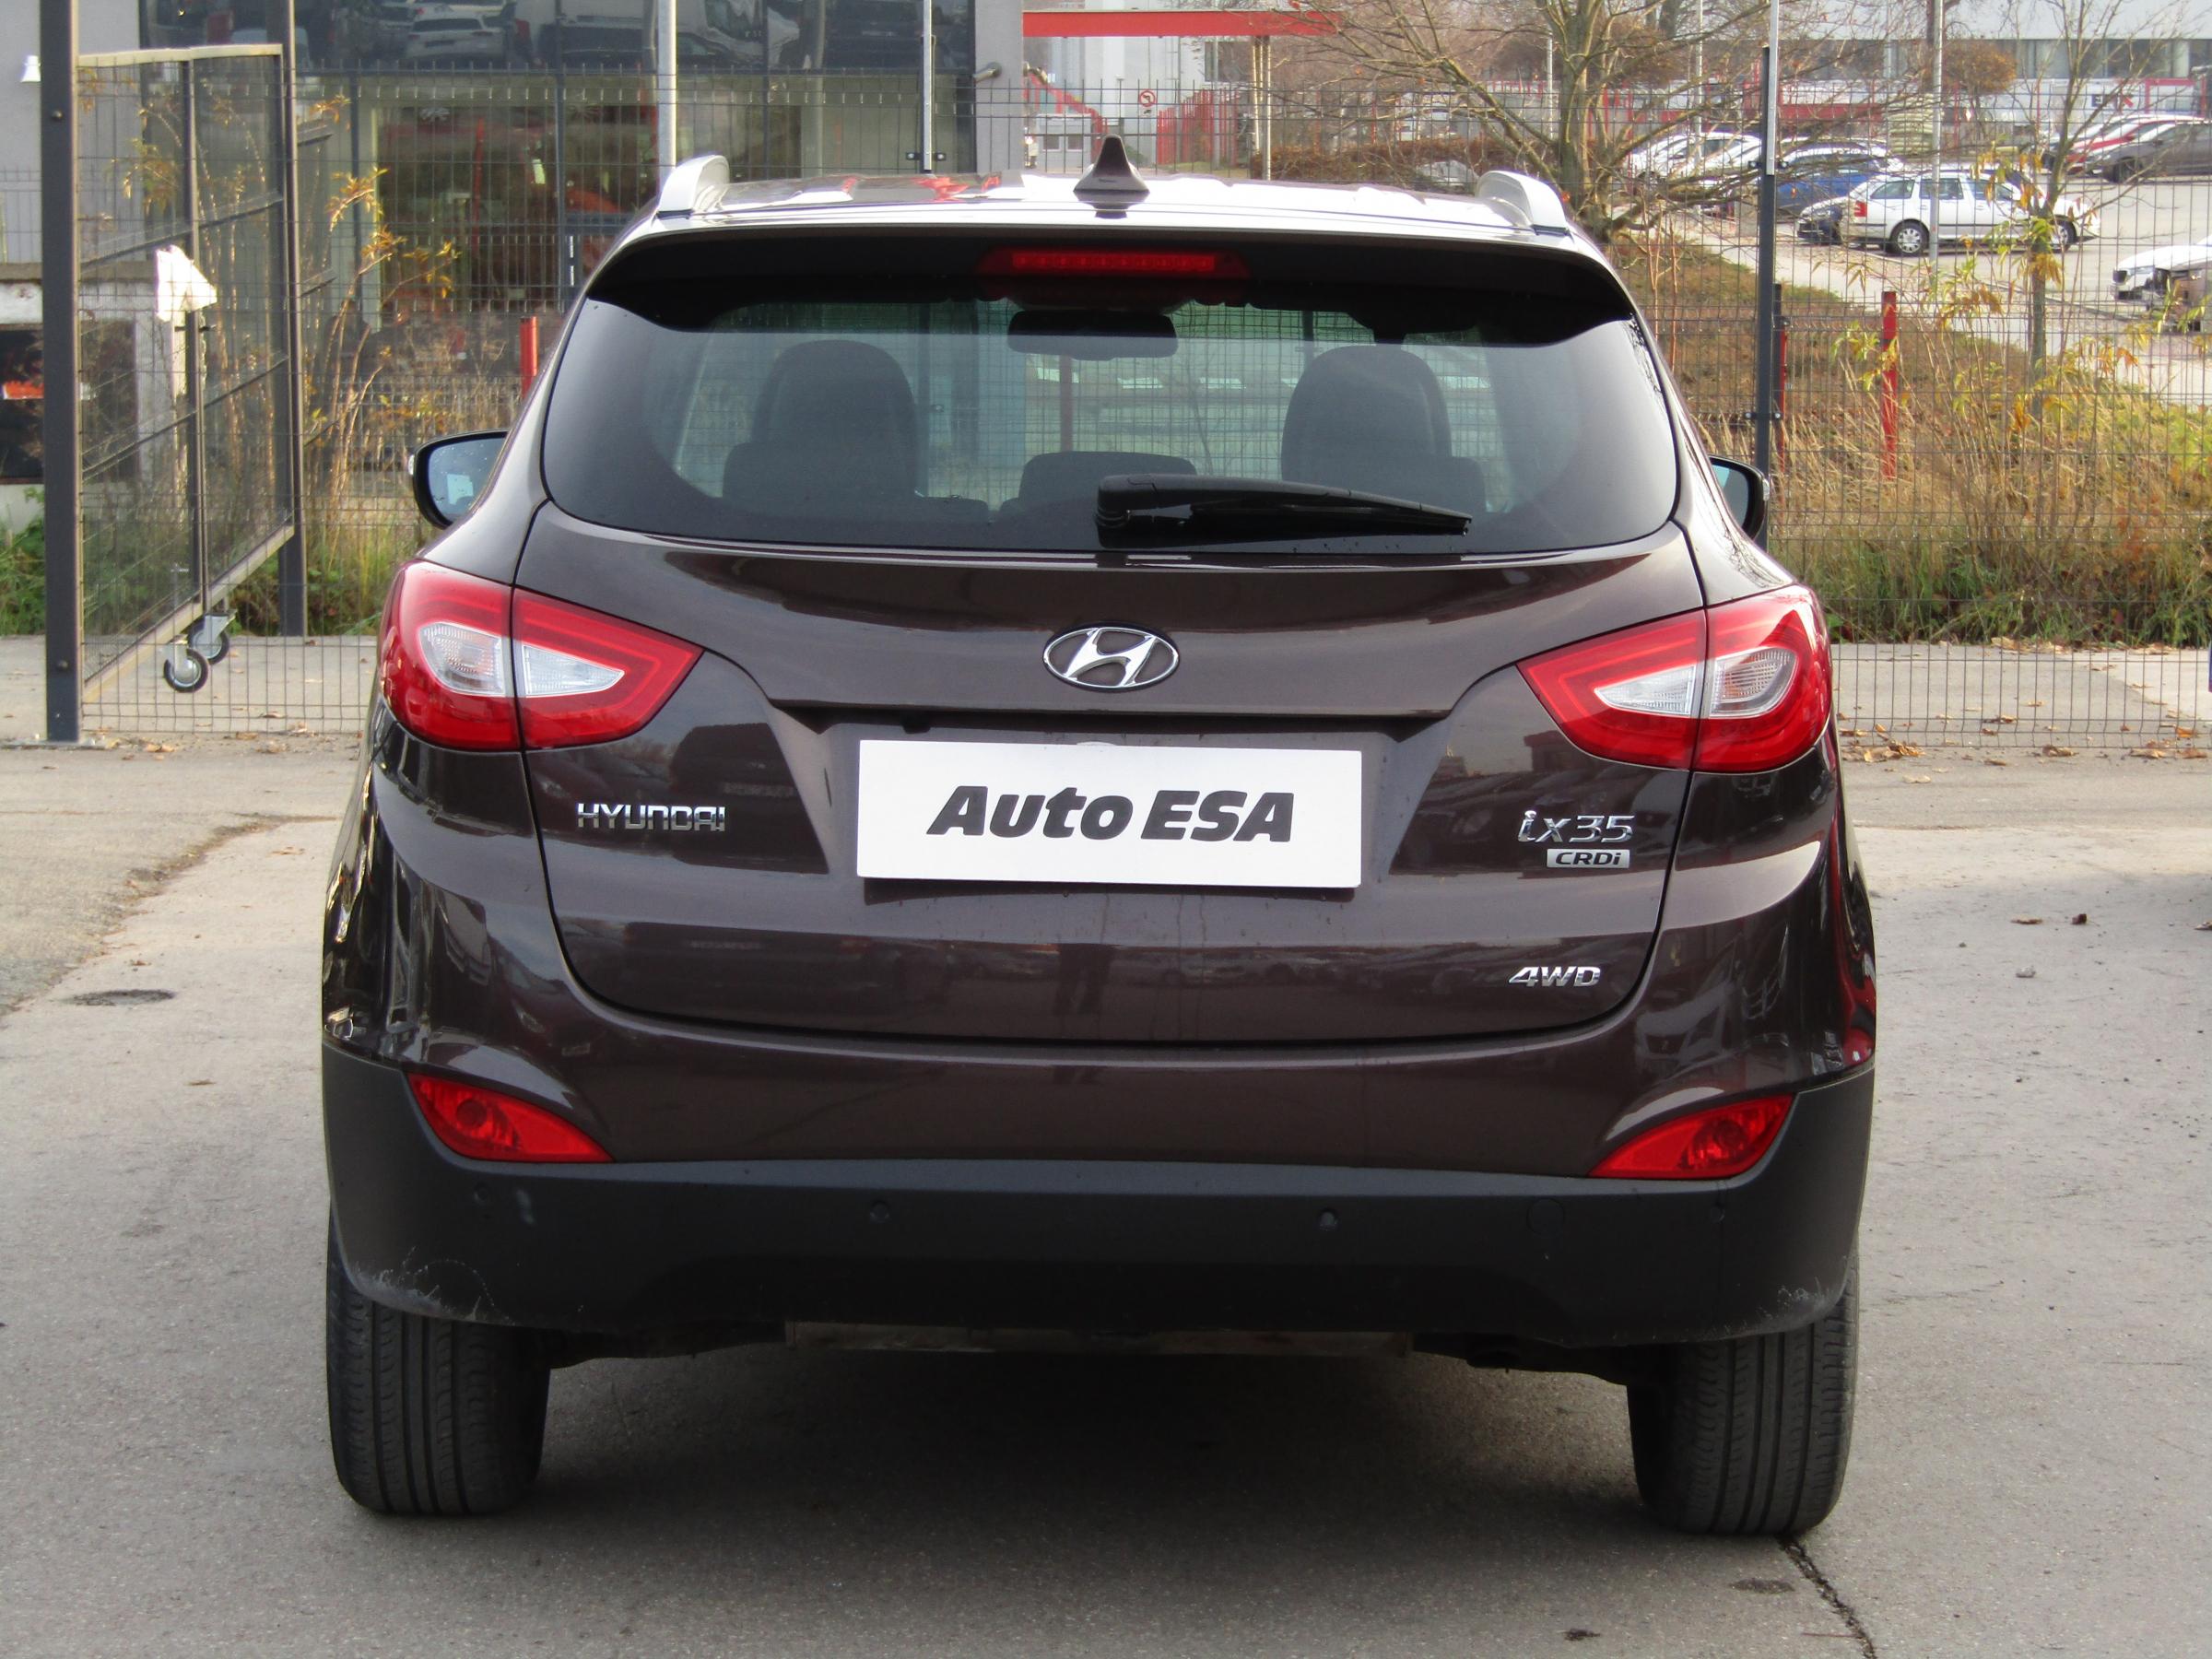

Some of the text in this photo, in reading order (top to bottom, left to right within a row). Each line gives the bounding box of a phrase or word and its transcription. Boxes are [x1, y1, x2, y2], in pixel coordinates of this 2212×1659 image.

[577, 803, 726, 831] HYUNDAI
[926, 785, 1295, 842] Auto ESA
[1555, 852, 1621, 865] CRDi
[1508, 966, 1601, 987] 4WD
